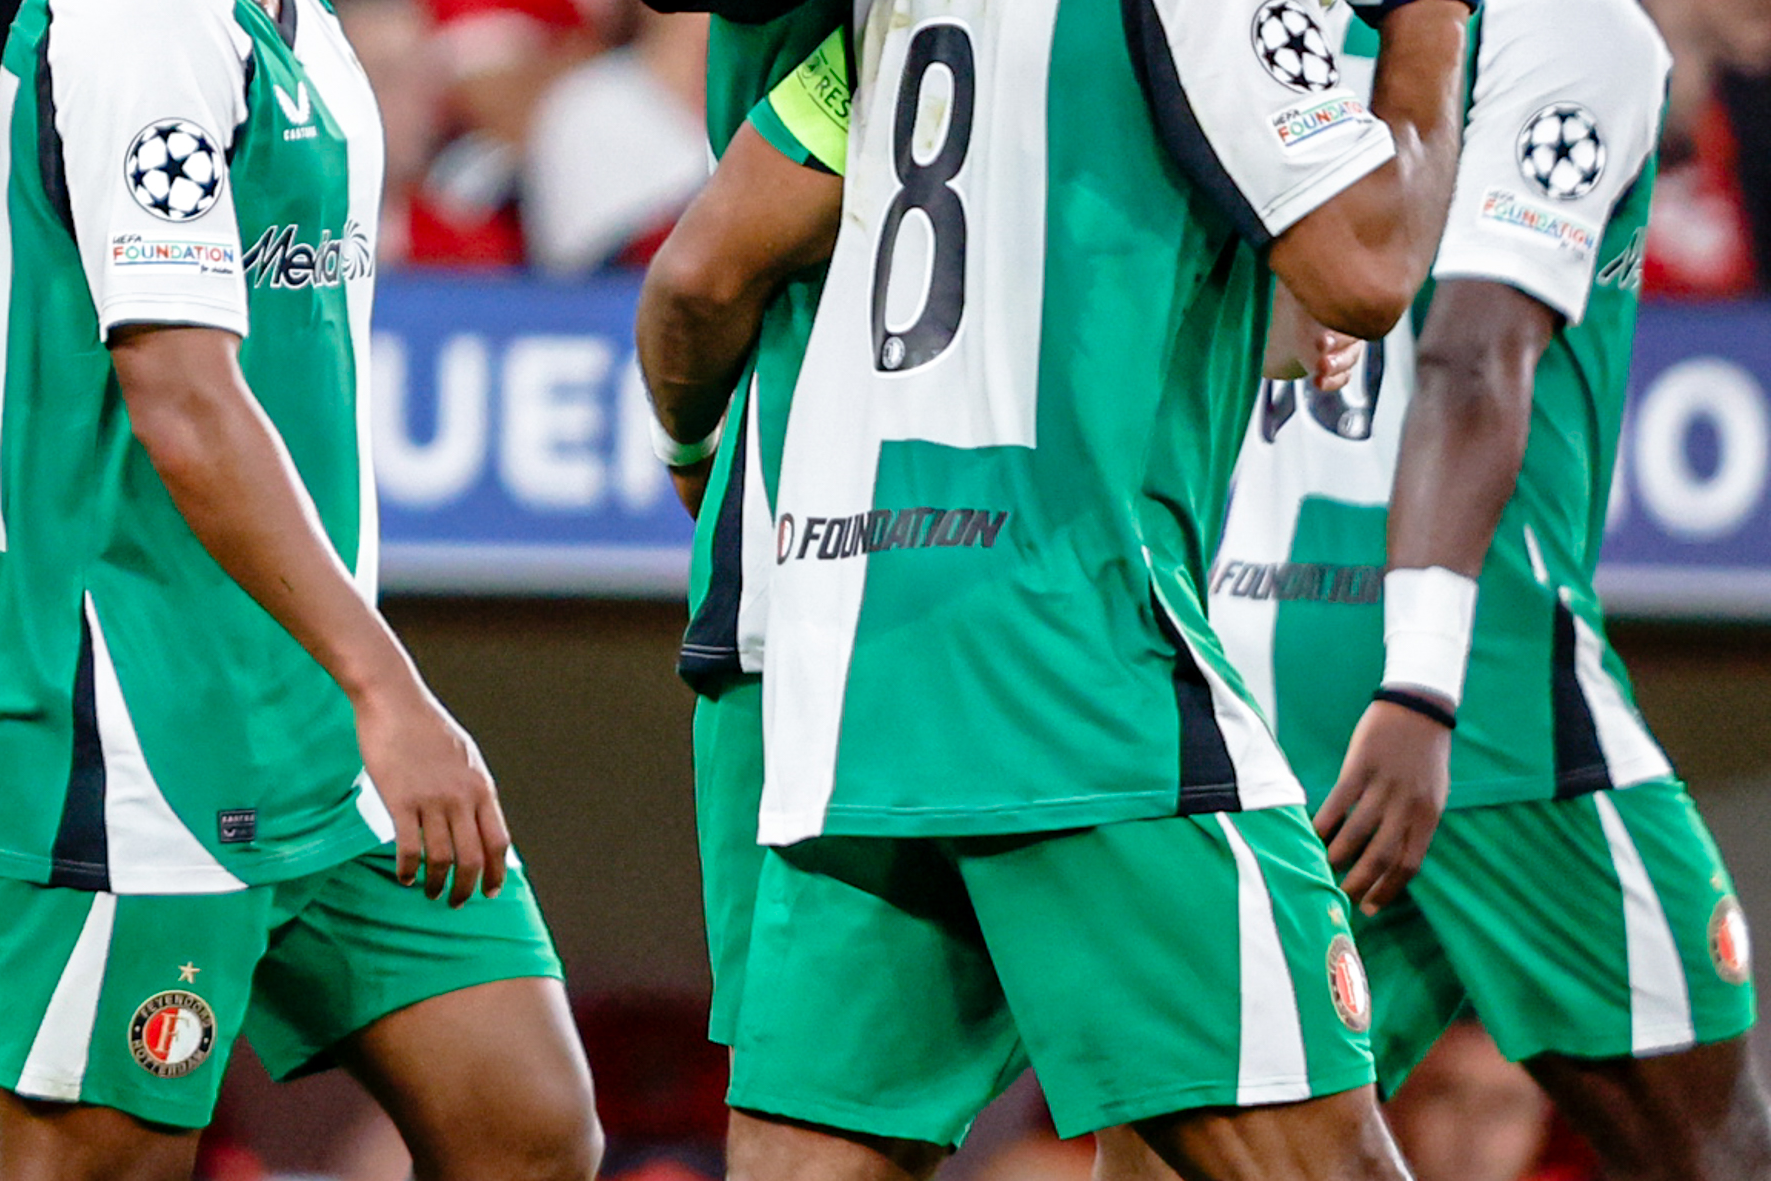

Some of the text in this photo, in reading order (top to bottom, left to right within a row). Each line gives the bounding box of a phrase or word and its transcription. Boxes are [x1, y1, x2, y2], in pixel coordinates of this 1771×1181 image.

[815, 76, 852, 121] RES
[870, 17, 975, 379] 8
[113, 234, 142, 244] UEFA
[113, 244, 234, 263] FOUNDATION
[795, 506, 1010, 560] FOUNDATION
